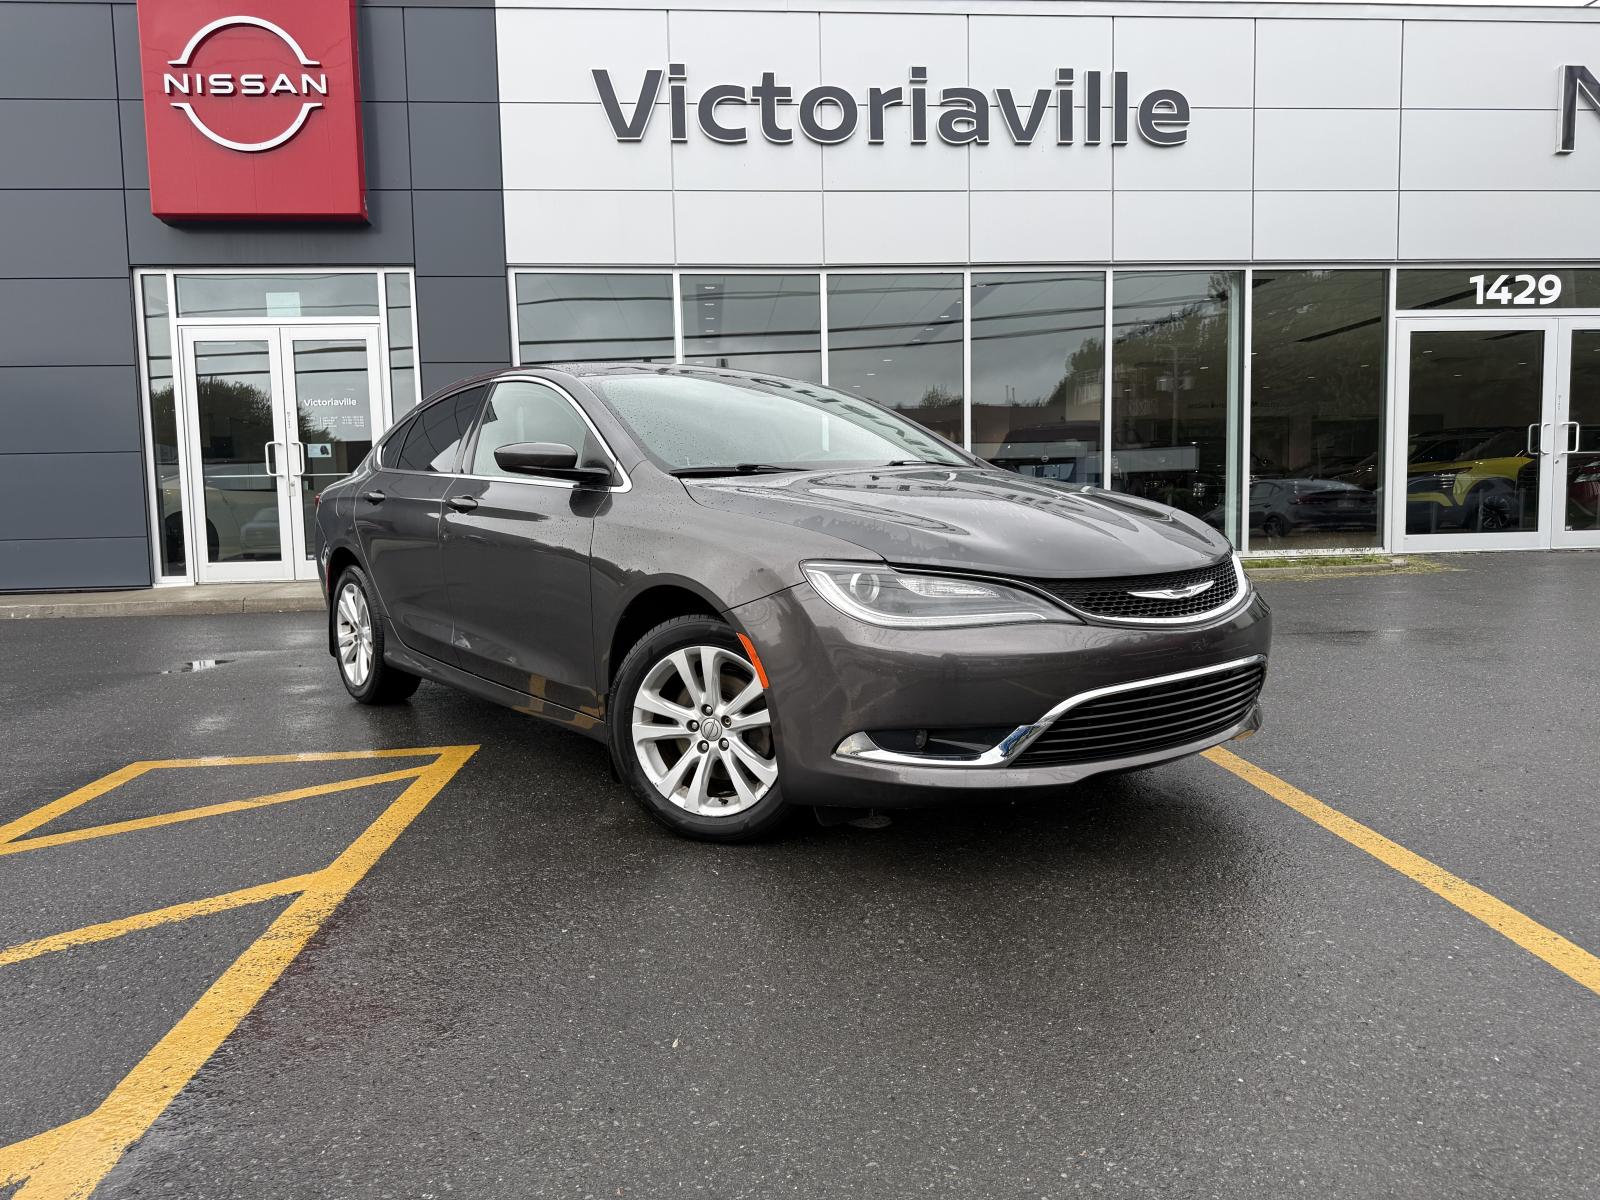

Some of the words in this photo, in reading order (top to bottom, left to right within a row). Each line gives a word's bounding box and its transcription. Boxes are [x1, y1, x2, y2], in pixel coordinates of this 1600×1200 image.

[163, 73, 327, 95] NISSAN
[591, 64, 1192, 147] Victoriaville
[1469, 274, 1562, 305] 1429
[304, 398, 357, 406] Victoriaville
